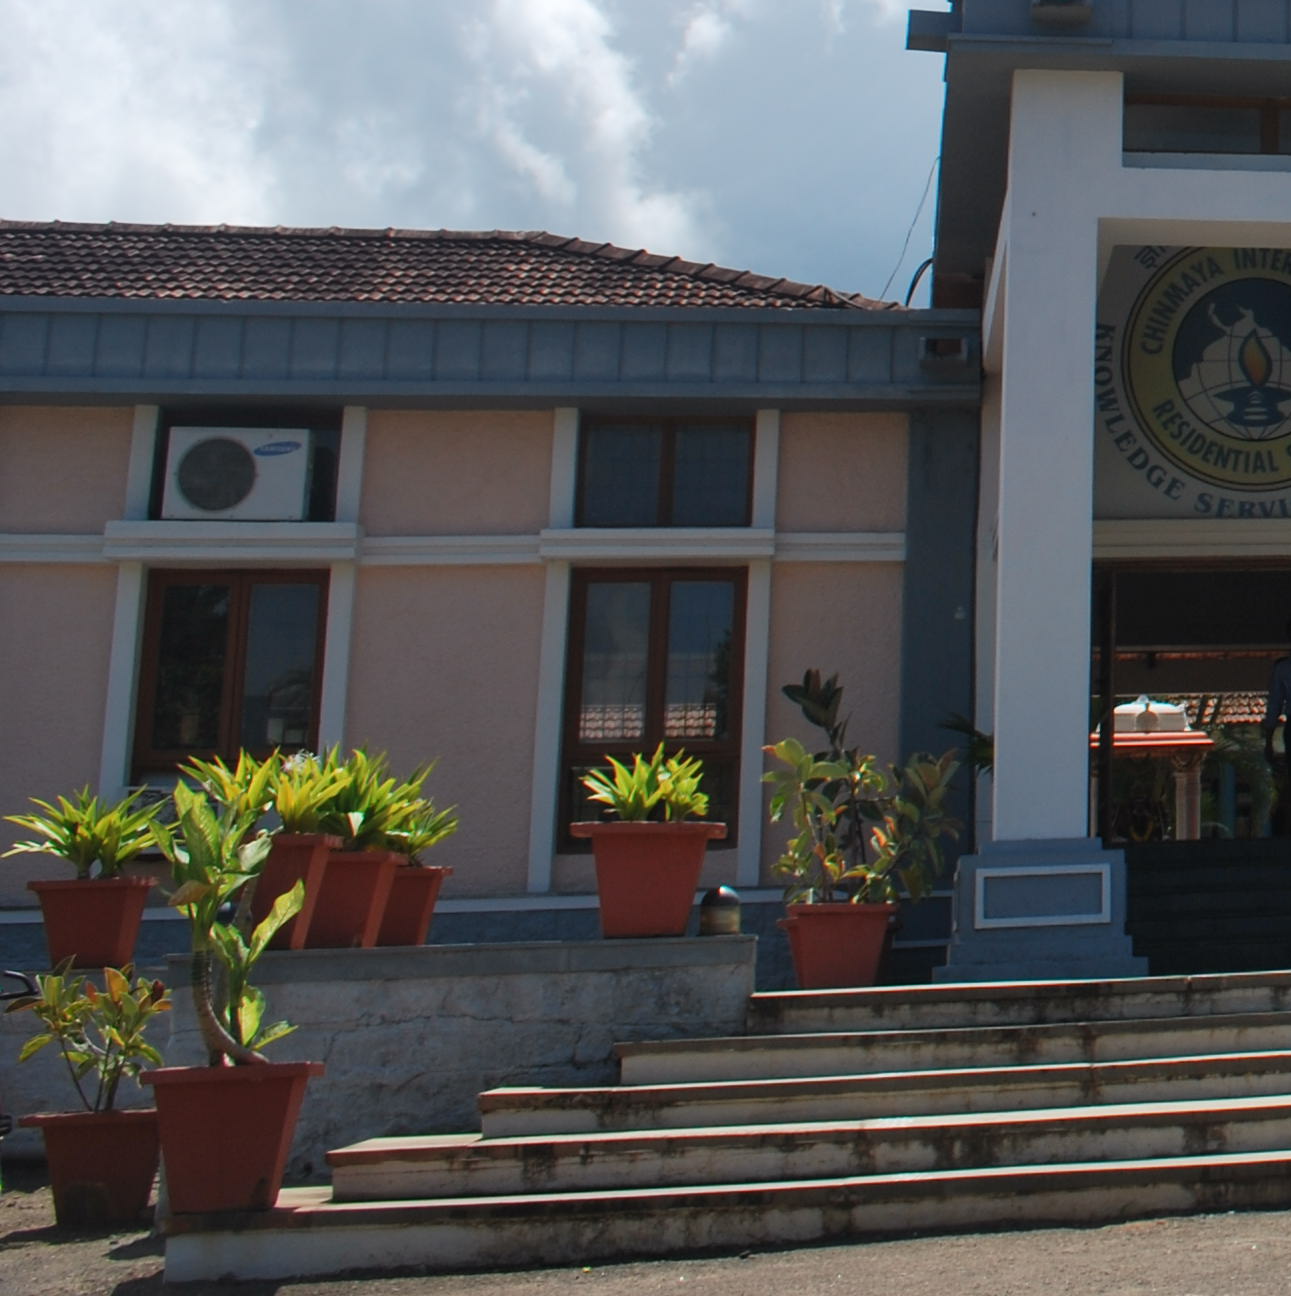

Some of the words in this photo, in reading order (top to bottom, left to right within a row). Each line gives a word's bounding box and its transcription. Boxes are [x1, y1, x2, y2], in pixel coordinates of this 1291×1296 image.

[1139, 256, 1226, 356] CHINMAYA
[1095, 321, 1186, 501] KNOWLEDGE
[1151, 398, 1281, 475] RESIDENTIAL
